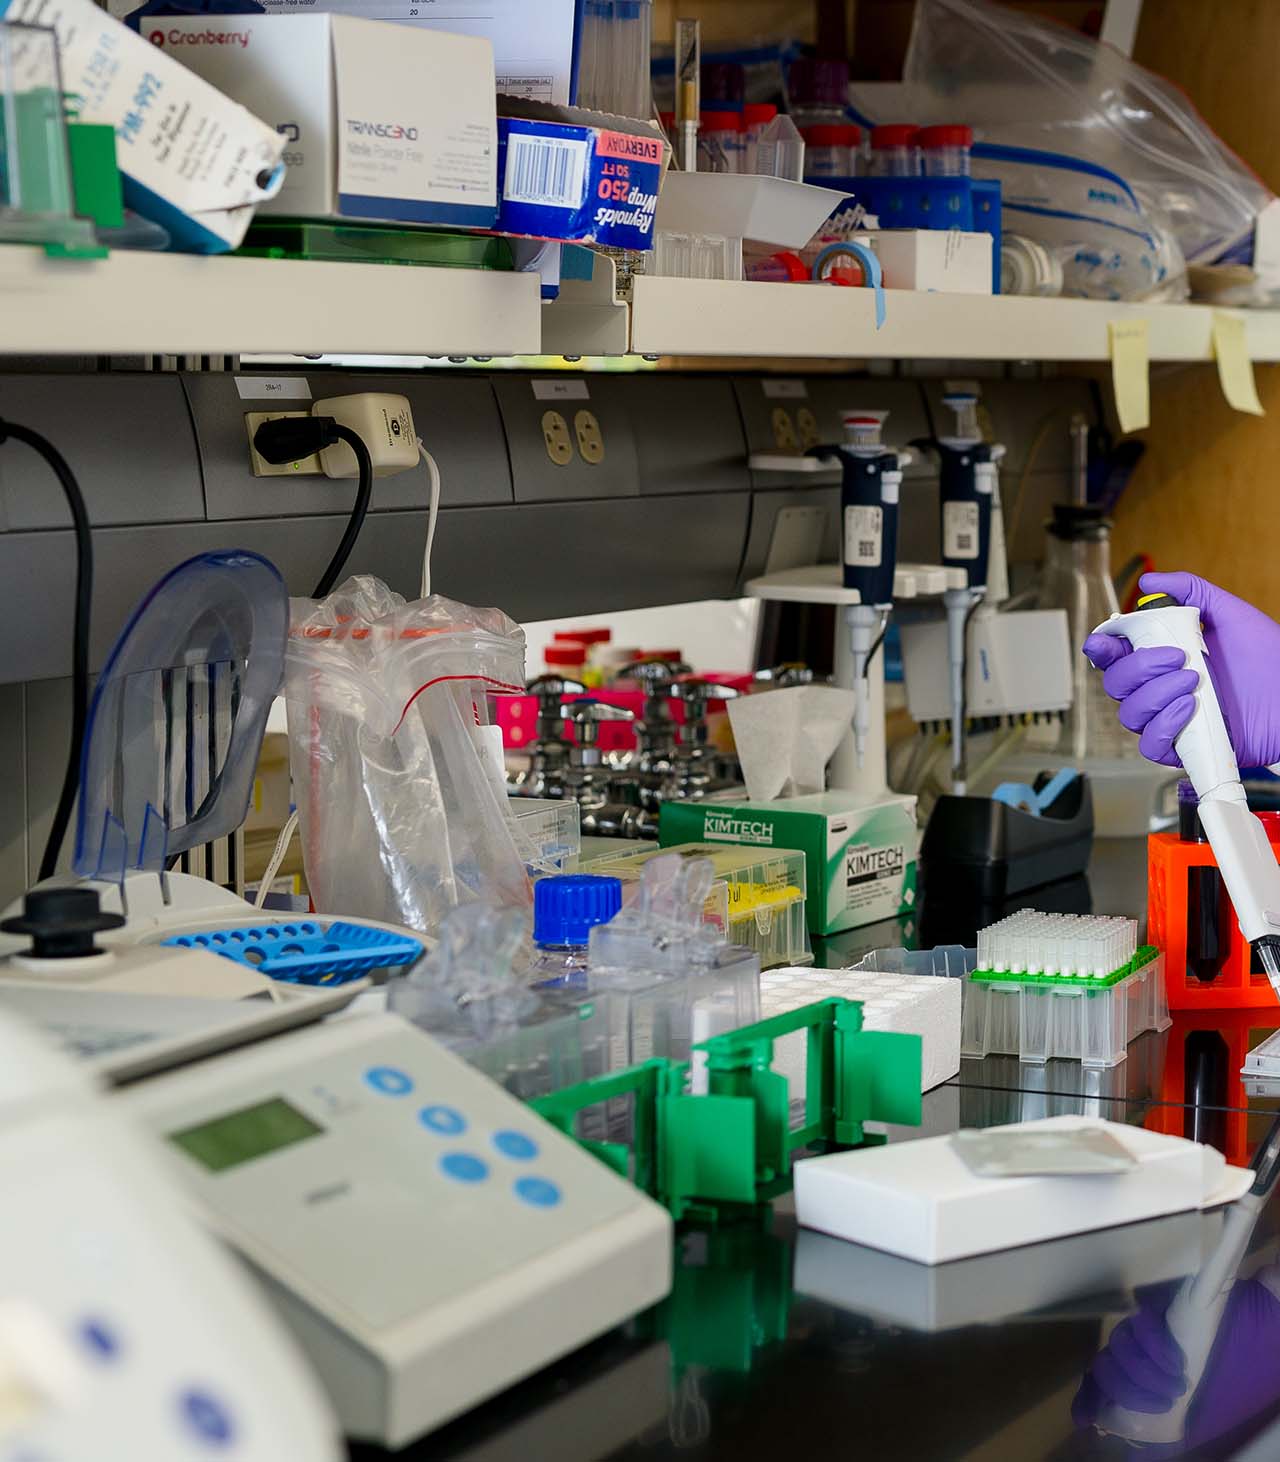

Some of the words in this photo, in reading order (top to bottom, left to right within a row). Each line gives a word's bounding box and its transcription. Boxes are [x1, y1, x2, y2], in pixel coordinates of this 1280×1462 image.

[409, 8, 419, 16] 20
[167, 30, 249, 48] Cranberry
[607, 136, 657, 158] EVERYDAY
[601, 162, 615, 176] FT
[616, 164, 630, 178] SQ
[598, 178, 629, 202] 250
[627, 187, 658, 214] Wrap
[593, 207, 654, 234] Reynolds
[704, 817, 774, 836] KIMTECH
[846, 846, 903, 875] KIMTECH
